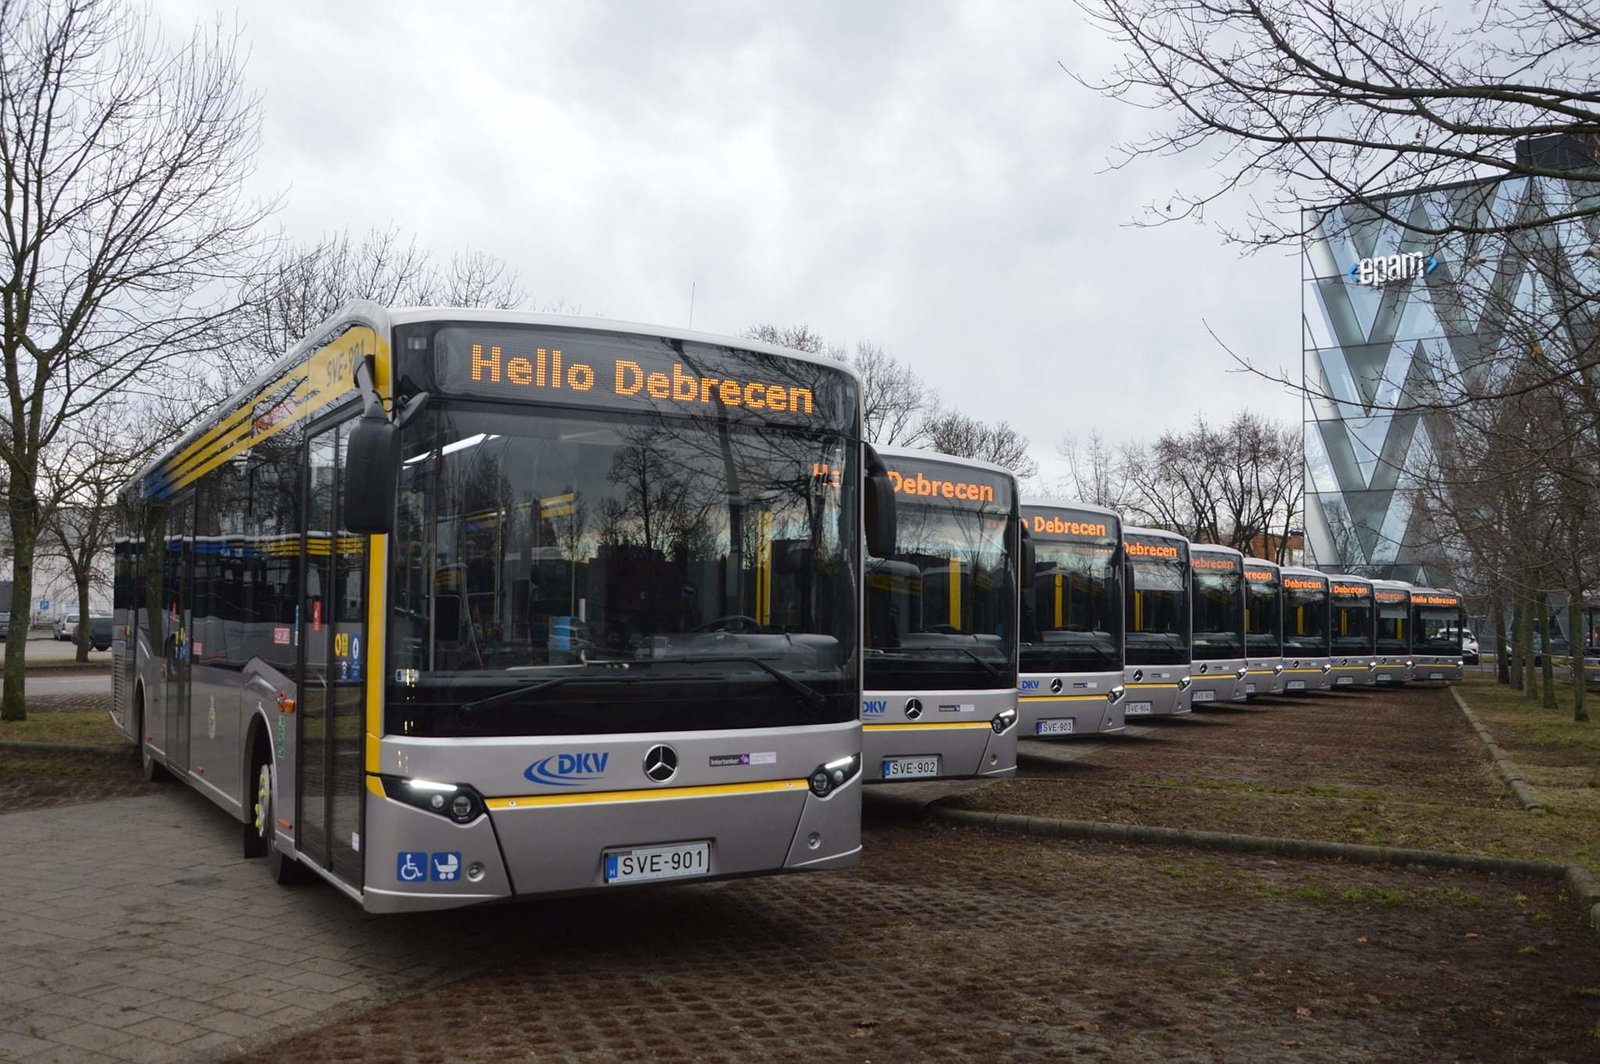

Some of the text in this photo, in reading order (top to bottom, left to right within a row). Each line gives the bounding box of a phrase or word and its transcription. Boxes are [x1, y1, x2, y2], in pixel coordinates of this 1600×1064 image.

[1360, 251, 1424, 287] epam
[471, 344, 813, 414] Hello Debrecen
[1034, 516, 1106, 537] Debrecen
[1284, 578, 1322, 589] Debrecen
[1333, 585, 1368, 595] Debrecen
[1022, 680, 1039, 690] DKV
[1043, 721, 1072, 732] SVE-903
[558, 752, 609, 775] DKV
[892, 761, 936, 775] SVE-902
[622, 851, 703, 876] SVE-901
